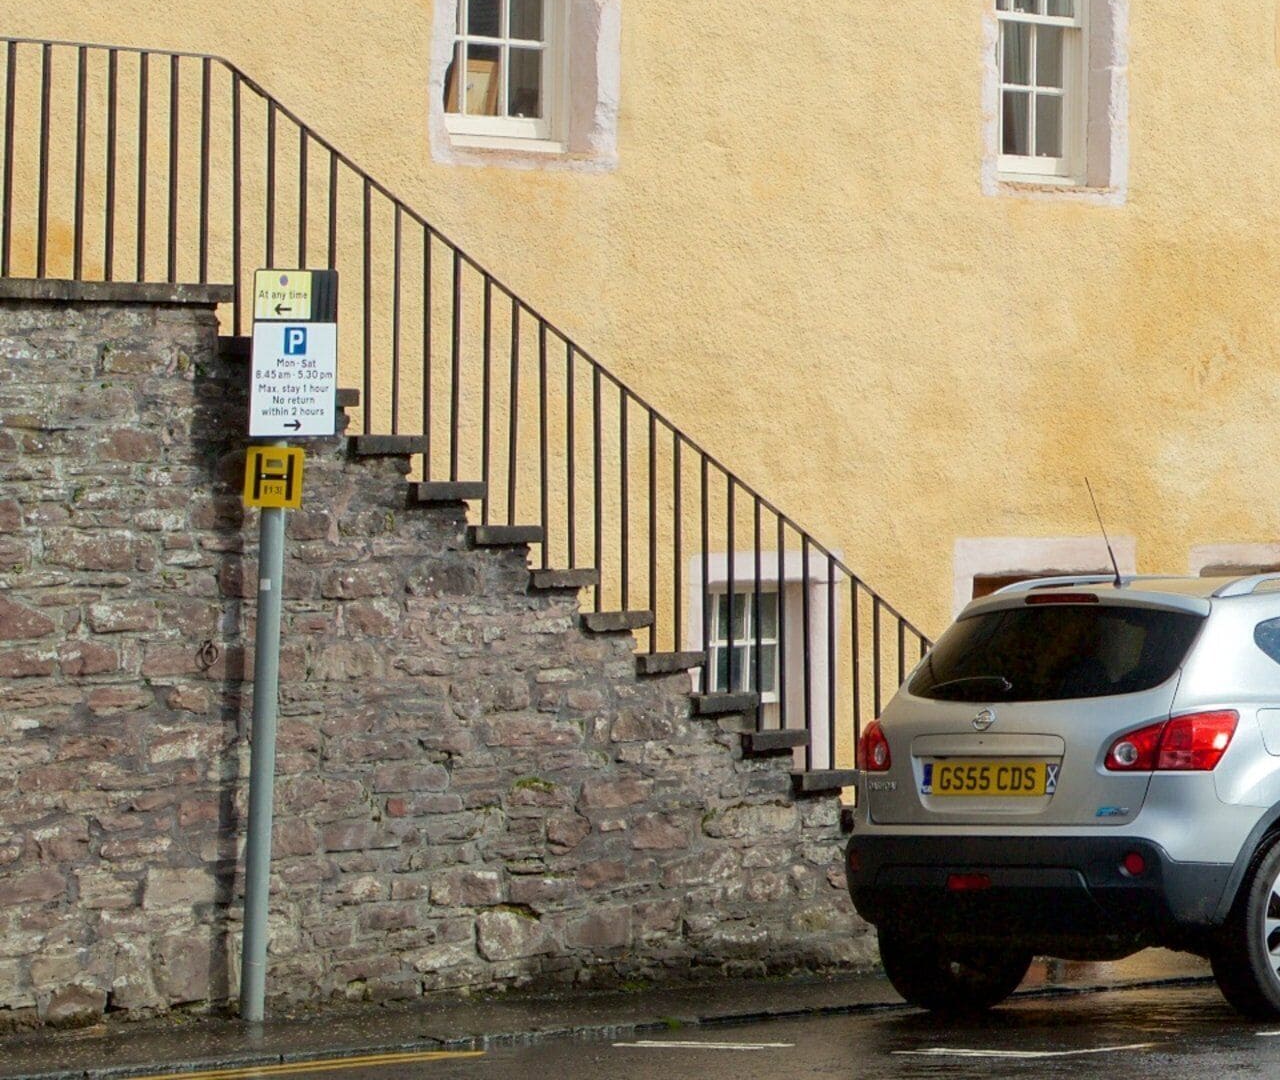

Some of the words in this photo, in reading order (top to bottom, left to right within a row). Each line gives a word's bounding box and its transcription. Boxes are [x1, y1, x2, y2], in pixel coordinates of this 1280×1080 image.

[259, 290, 269, 299] At
[271, 292, 286, 301] any
[289, 290, 308, 300] time
[289, 329, 304, 354] P
[282, 384, 300, 395] stay
[309, 384, 329, 393] hour
[272, 395, 285, 405] No
[287, 396, 316, 405] return
[261, 407, 288, 416] within
[300, 407, 325, 417] hours
[940, 766, 990, 790] GS55
[997, 766, 1036, 791] CDS
